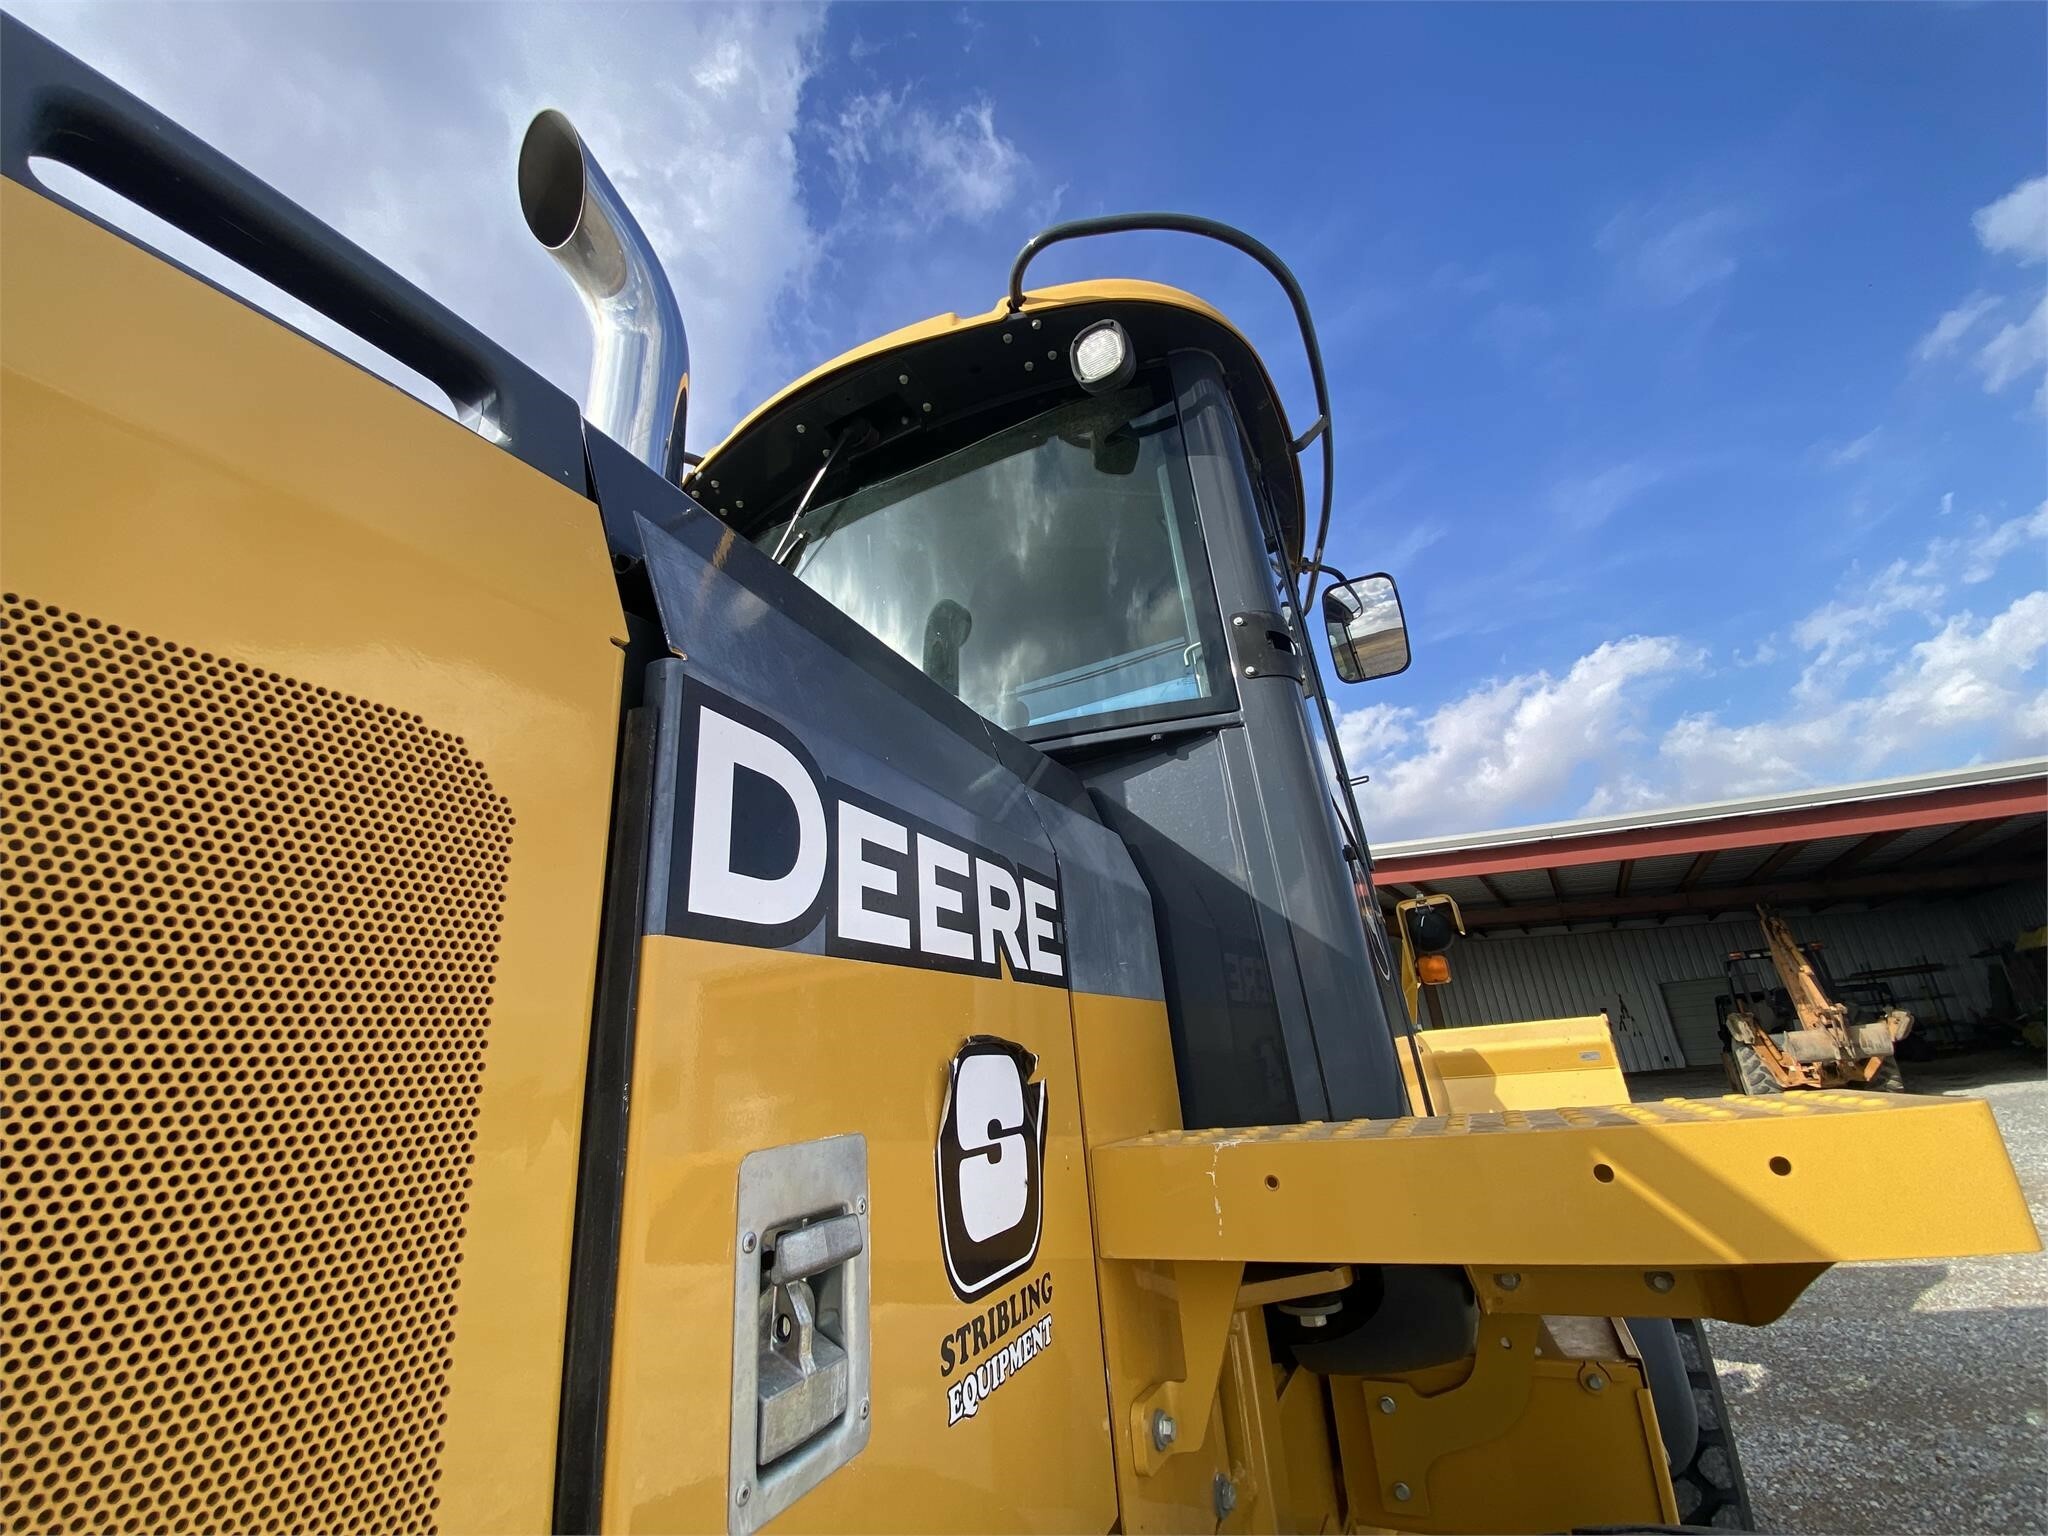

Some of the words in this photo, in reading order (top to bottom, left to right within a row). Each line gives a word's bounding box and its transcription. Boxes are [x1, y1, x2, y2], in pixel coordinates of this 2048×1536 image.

[687, 704, 1064, 977] DEERE
[956, 1054, 1028, 1243] S
[940, 1272, 1053, 1377] STRIBLING
[947, 1313, 1052, 1427] EQUIPMENT
